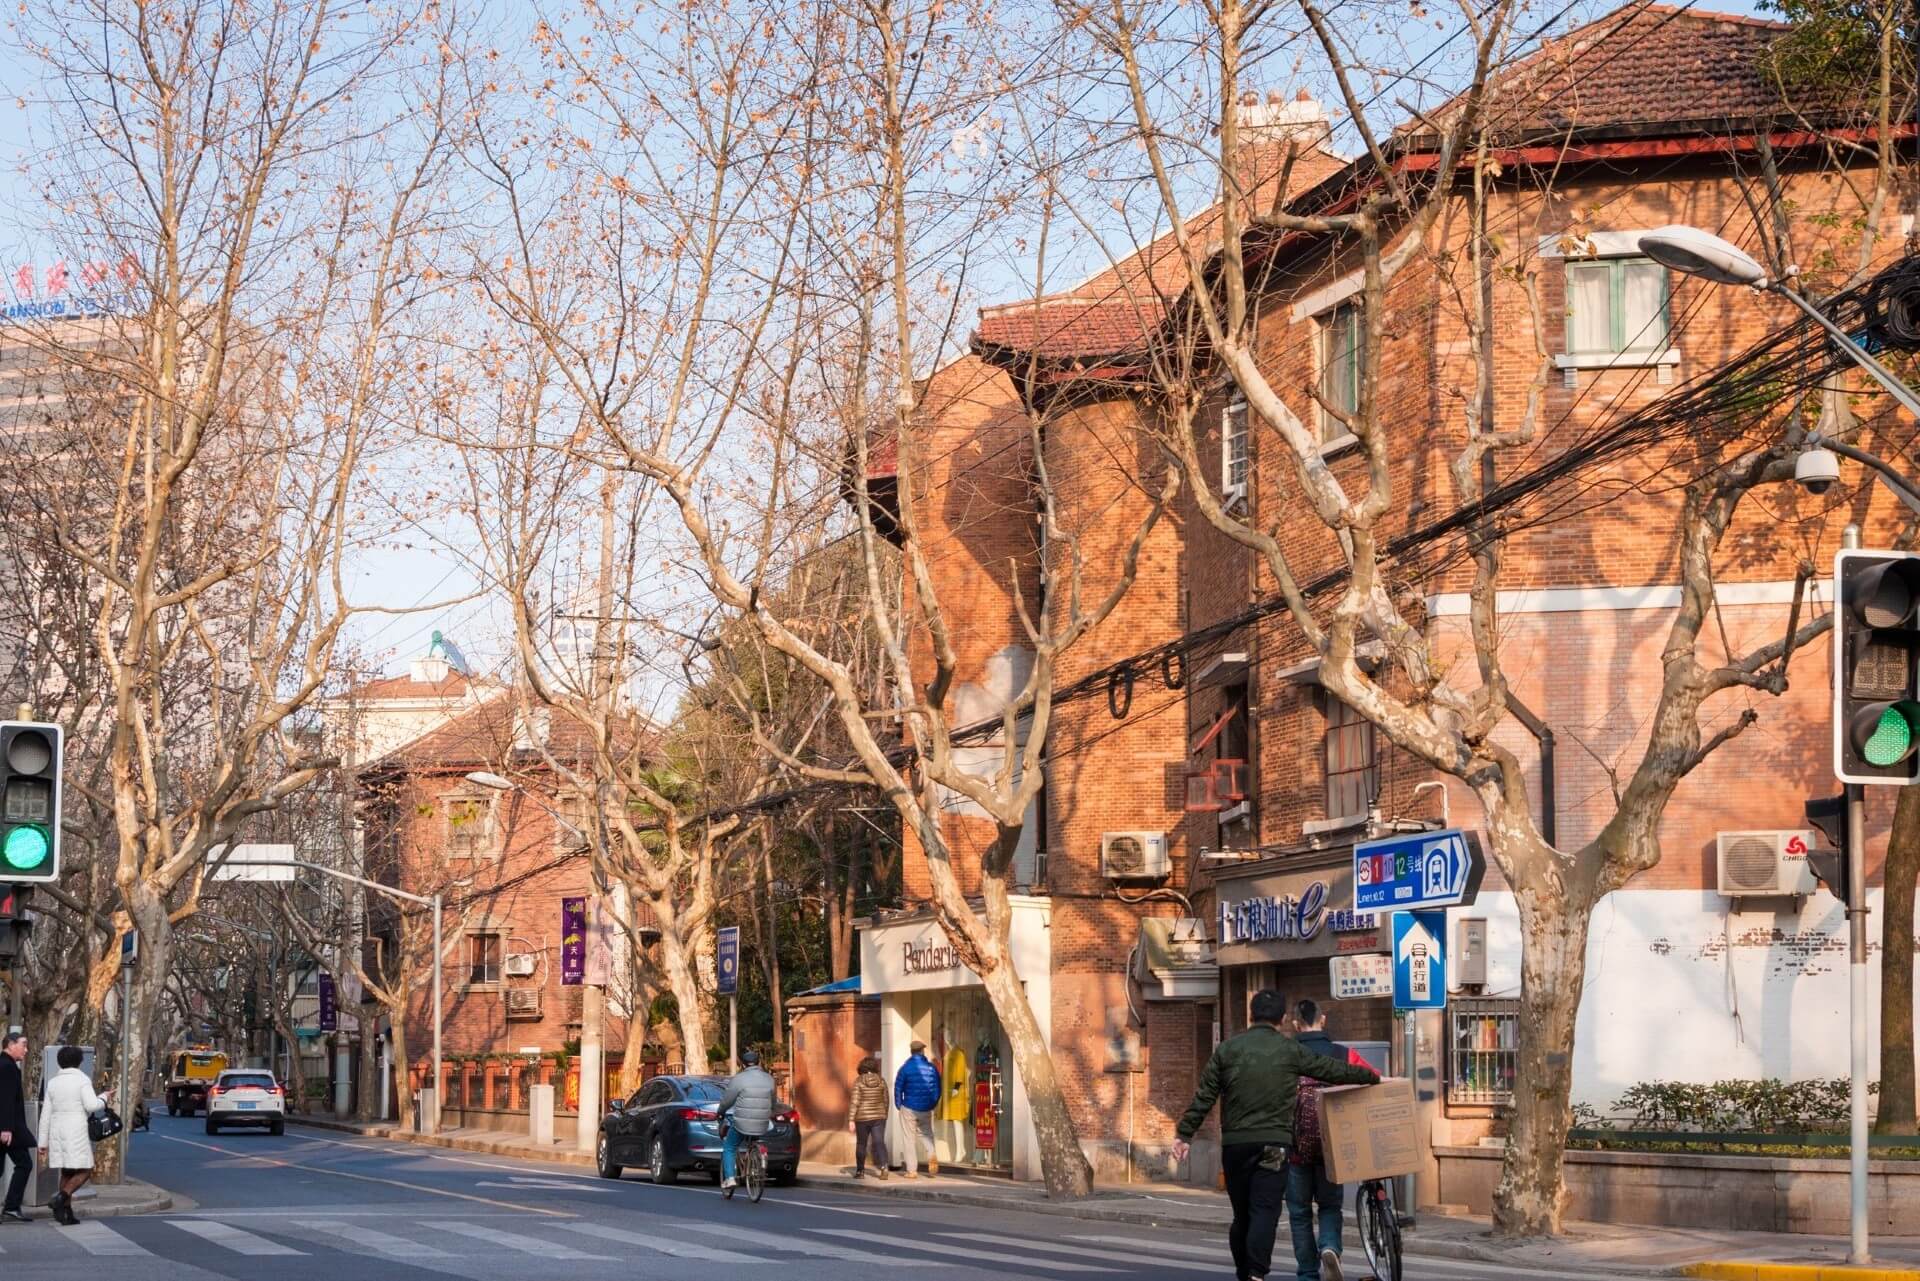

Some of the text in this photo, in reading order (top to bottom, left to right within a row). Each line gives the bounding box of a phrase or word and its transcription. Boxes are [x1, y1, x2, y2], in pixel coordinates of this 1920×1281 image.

[1373, 855, 1423, 878] 1 10 12 号线
[903, 938, 960, 974] Penderie
[1413, 959, 1427, 993] 单行道
